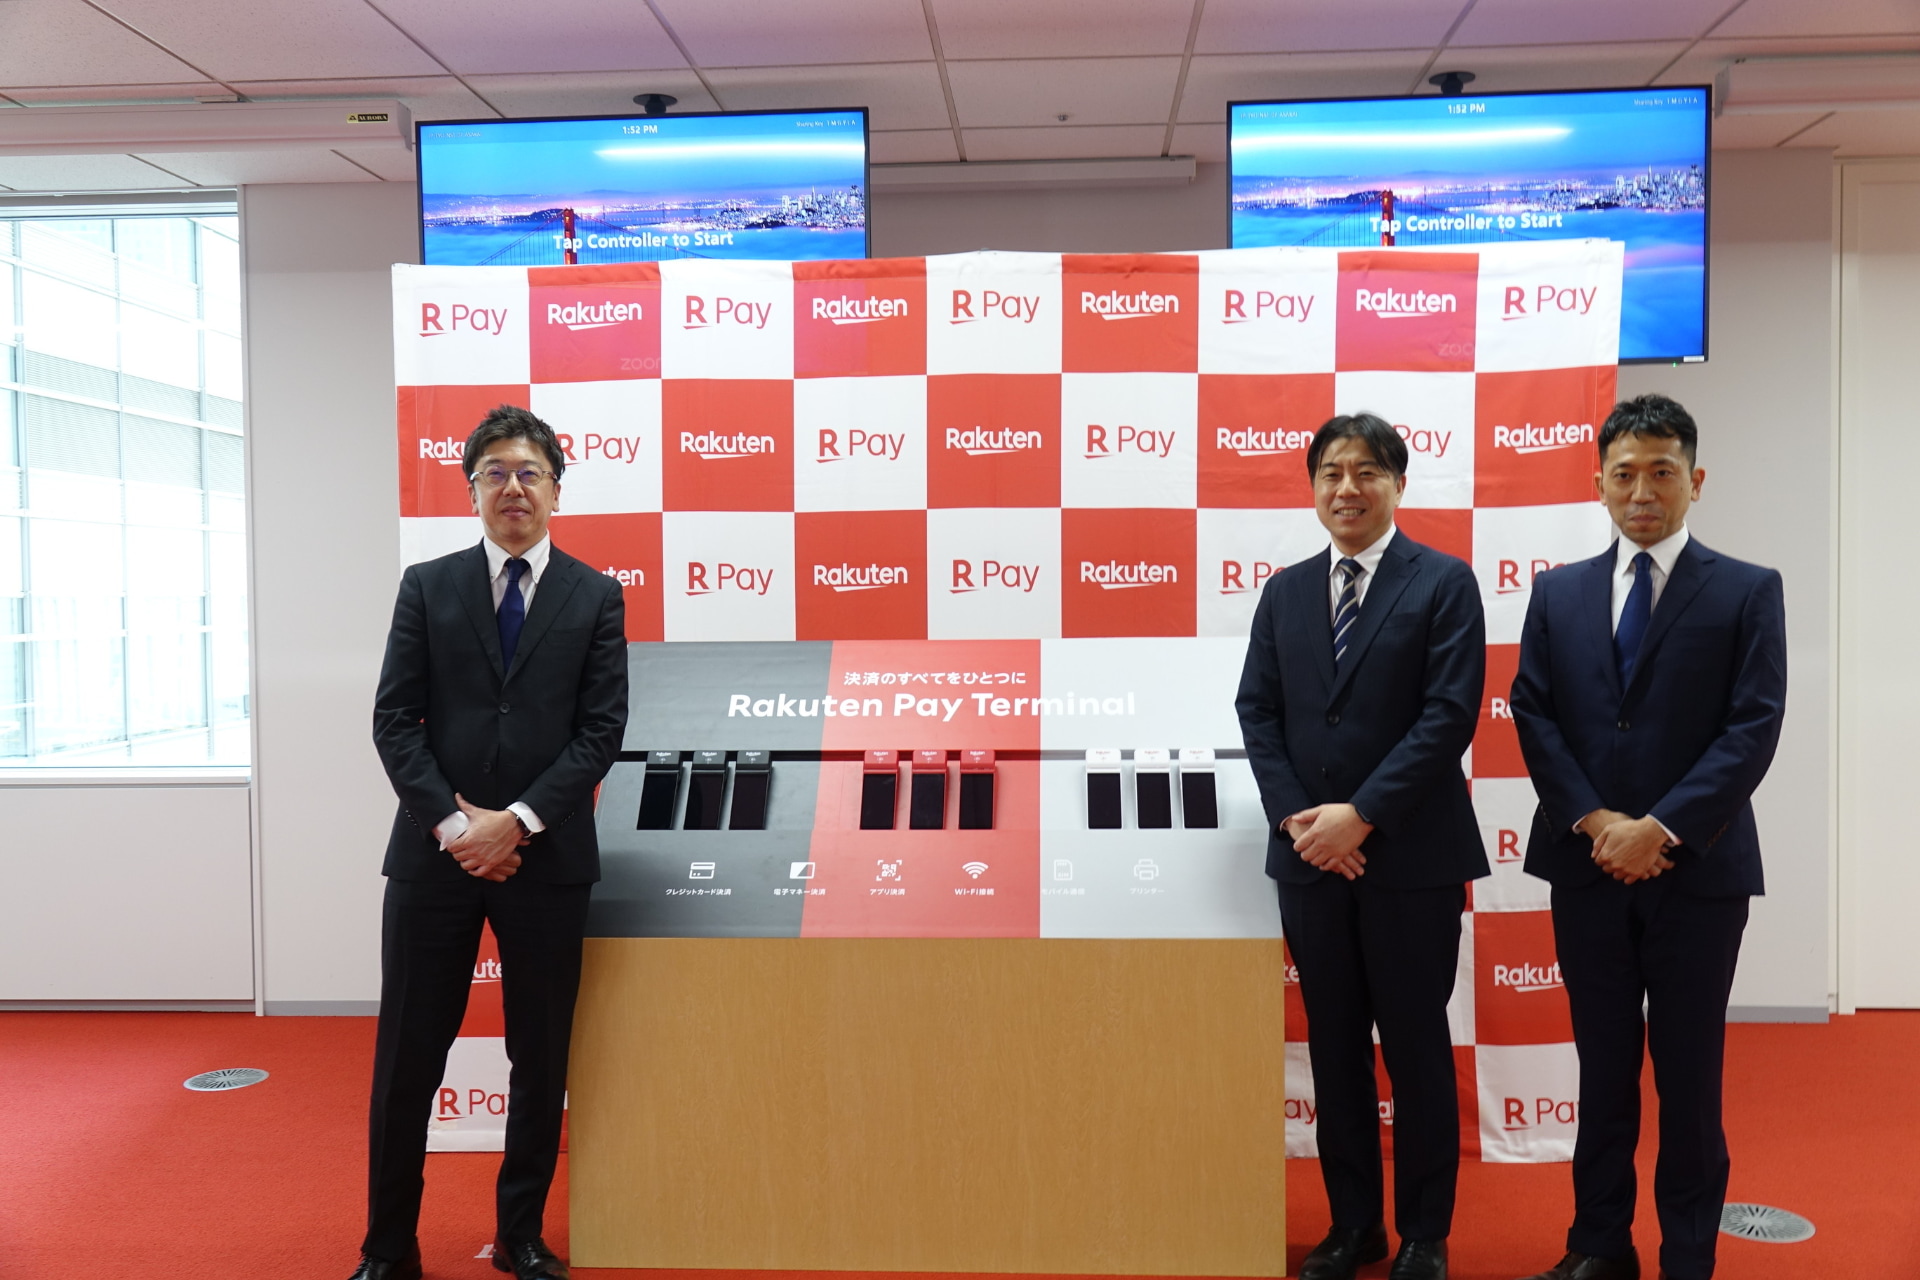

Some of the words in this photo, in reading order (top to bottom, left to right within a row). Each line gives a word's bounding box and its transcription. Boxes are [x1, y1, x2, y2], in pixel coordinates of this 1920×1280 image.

[1448, 104, 1467, 114] 1:52
[1469, 103, 1485, 113] PM
[622, 125, 641, 134] 1:52
[643, 125, 658, 134] PM
[1370, 216, 1401, 236] Tap
[1406, 213, 1492, 231] Controller
[1497, 214, 1515, 229] to
[1520, 212, 1563, 229] Start
[553, 235, 583, 253] Tap
[587, 232, 668, 248] Controller
[672, 233, 689, 246] to
[694, 231, 734, 246] Start
[547, 301, 642, 325] Rakuten
[684, 295, 709, 327] R
[716, 297, 772, 329] Pay
[812, 295, 908, 319] Rakuten
[950, 290, 976, 322] R
[983, 290, 1040, 323] Pay
[1081, 290, 1179, 314] Rakuten
[1223, 290, 1248, 321] R
[1256, 290, 1315, 322] Pay
[1355, 287, 1456, 313] Rakuten
[1503, 286, 1527, 318] R
[1537, 285, 1597, 315] Pay
[420, 303, 446, 334] R
[452, 304, 508, 335] Pay
[680, 431, 775, 454] Rakuten
[817, 428, 841, 460] R
[848, 429, 906, 460] Pay
[945, 426, 1042, 450] Rakuten
[1085, 424, 1110, 456] R
[1117, 425, 1176, 458] Pay
[1216, 426, 1314, 450] Rakuten
[1494, 422, 1594, 448] Rakuten
[585, 433, 641, 464] Pay
[686, 562, 711, 593] R
[717, 563, 774, 595] Pay
[813, 563, 908, 587] Rakuten
[951, 559, 977, 591] R
[983, 559, 1040, 592] Pay
[1080, 560, 1178, 585] Rakuten
[1221, 560, 1247, 592] R
[1253, 562, 1286, 589] P
[1497, 560, 1523, 591] R
[843, 671, 1026, 686] 決済のすべてをひとつに
[728, 693, 883, 717] Rakuten
[893, 693, 963, 722] Pay
[971, 691, 1136, 717] Terminal
[1497, 829, 1522, 861] R
[665, 888, 732, 896] クレジットカード決済
[773, 888, 826, 896] 電子マネー決済
[1129, 887, 1165, 895] プリンター
[437, 1088, 463, 1119] R
[469, 1089, 509, 1116] Pa
[1503, 1097, 1530, 1129] R
[1536, 1097, 1579, 1125] Pa
